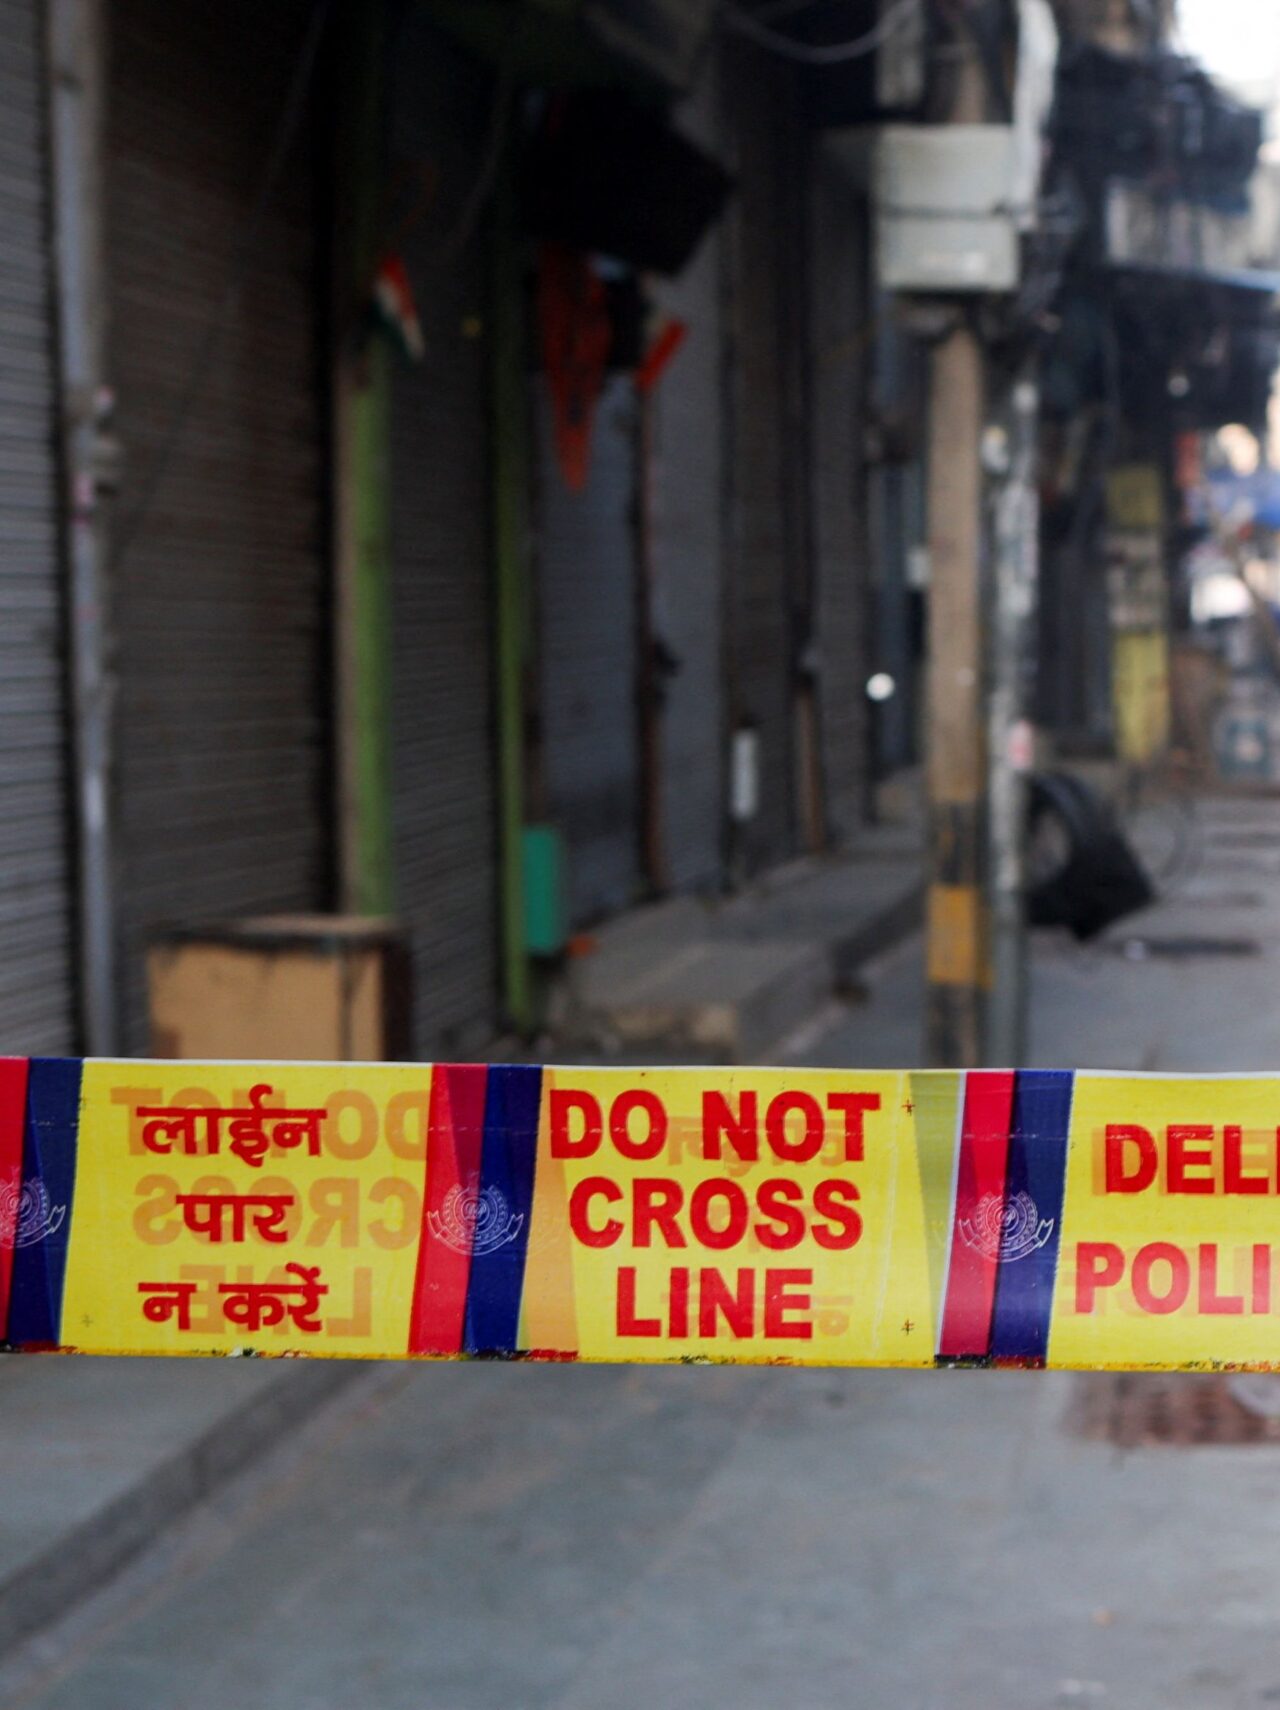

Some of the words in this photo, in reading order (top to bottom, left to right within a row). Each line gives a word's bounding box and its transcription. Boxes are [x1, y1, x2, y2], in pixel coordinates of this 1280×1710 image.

[136, 1084, 328, 1168] लाईन
[549, 1088, 669, 1161] DO
[701, 1090, 881, 1163] NOT
[176, 1195, 295, 1243] पार
[569, 1176, 863, 1250] CROSS
[138, 1282, 197, 1332] न
[218, 1262, 329, 1333] करें
[616, 1266, 813, 1340] LINE
